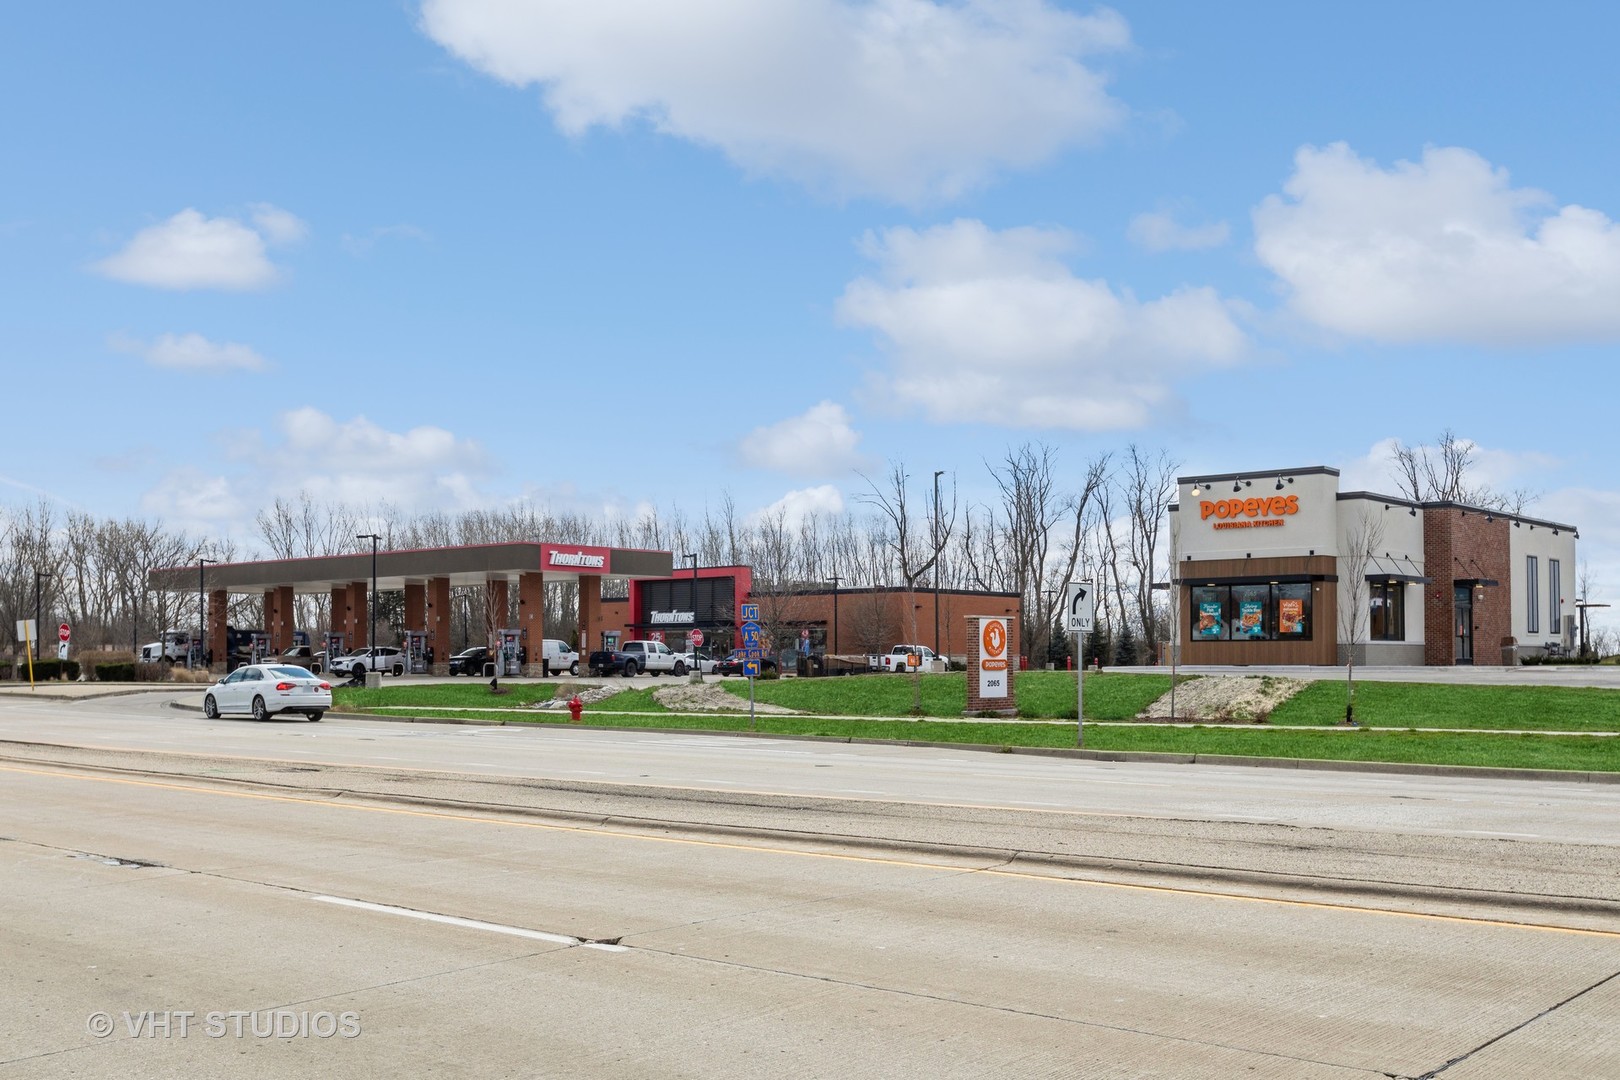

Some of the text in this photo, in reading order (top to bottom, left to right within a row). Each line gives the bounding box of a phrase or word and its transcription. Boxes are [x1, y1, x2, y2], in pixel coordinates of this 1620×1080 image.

[1200, 495, 1299, 520] POPEYES
[1213, 519, 1285, 530] LOUISIANA KITCHEN
[743, 607, 758, 618] JCT
[1071, 617, 1090, 627] ONLY
[744, 631, 759, 641] A 50
